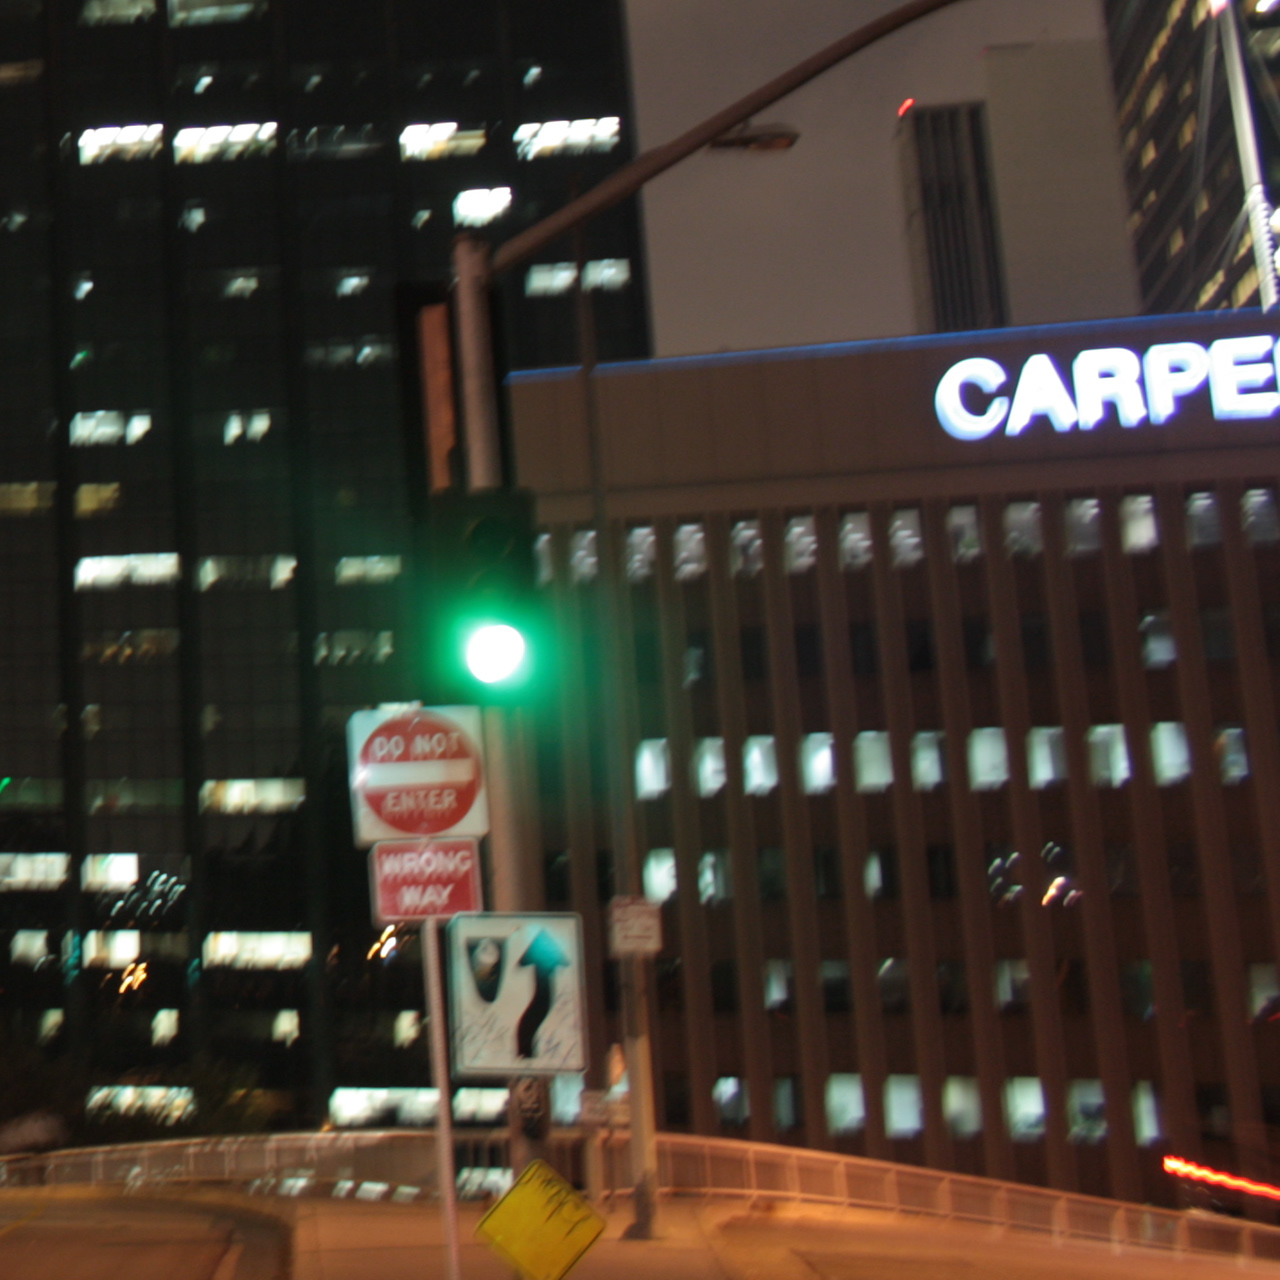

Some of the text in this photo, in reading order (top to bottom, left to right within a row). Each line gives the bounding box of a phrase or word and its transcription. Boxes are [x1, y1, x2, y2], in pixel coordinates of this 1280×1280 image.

[934, 333, 1280, 441] CARPE
[372, 732, 461, 758] DO NOT
[383, 788, 458, 813] ENTER
[381, 850, 473, 876] WRONG
[401, 882, 455, 907] WAY
